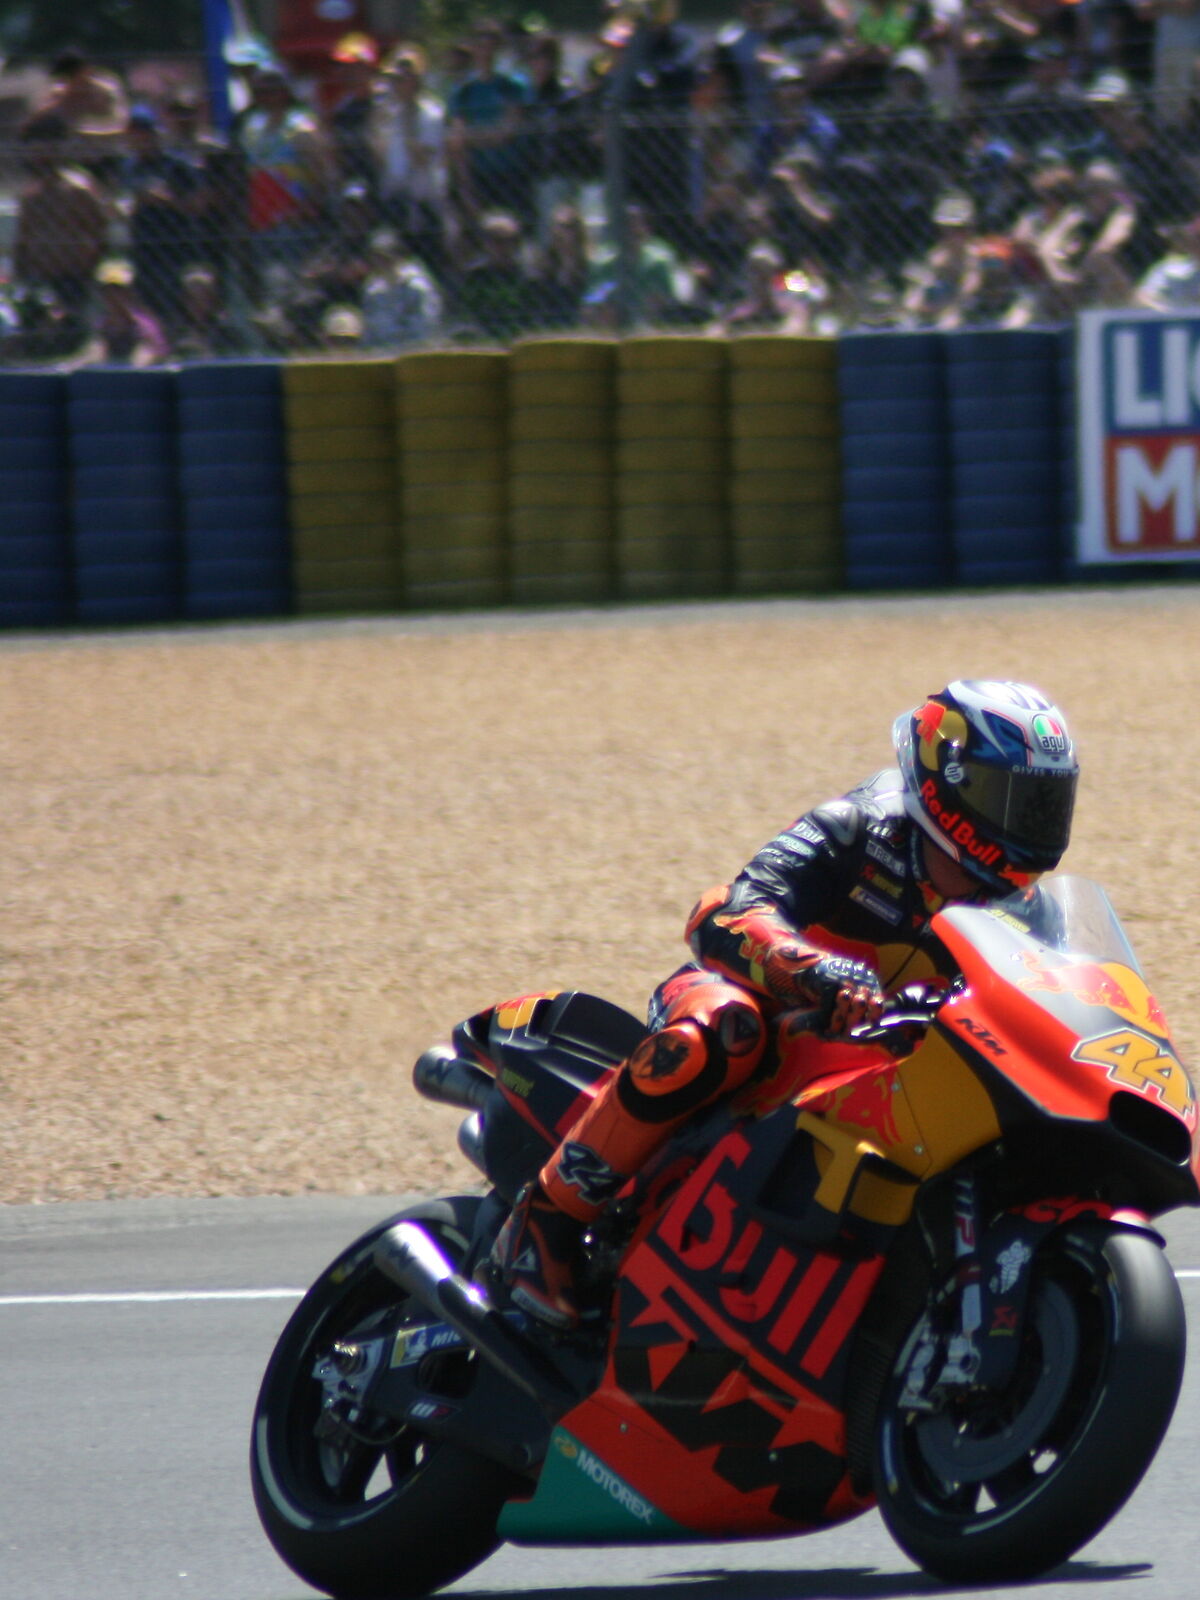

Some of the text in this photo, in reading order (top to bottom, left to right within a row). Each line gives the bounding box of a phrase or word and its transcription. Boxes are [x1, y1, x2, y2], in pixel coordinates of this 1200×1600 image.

[920, 779, 1004, 866] Red Bull
[956, 1017, 1009, 1057] KTM
[1071, 1027, 1196, 1119] 44
[556, 1142, 630, 1207] 44
[576, 1447, 656, 1525] MOTOREX
